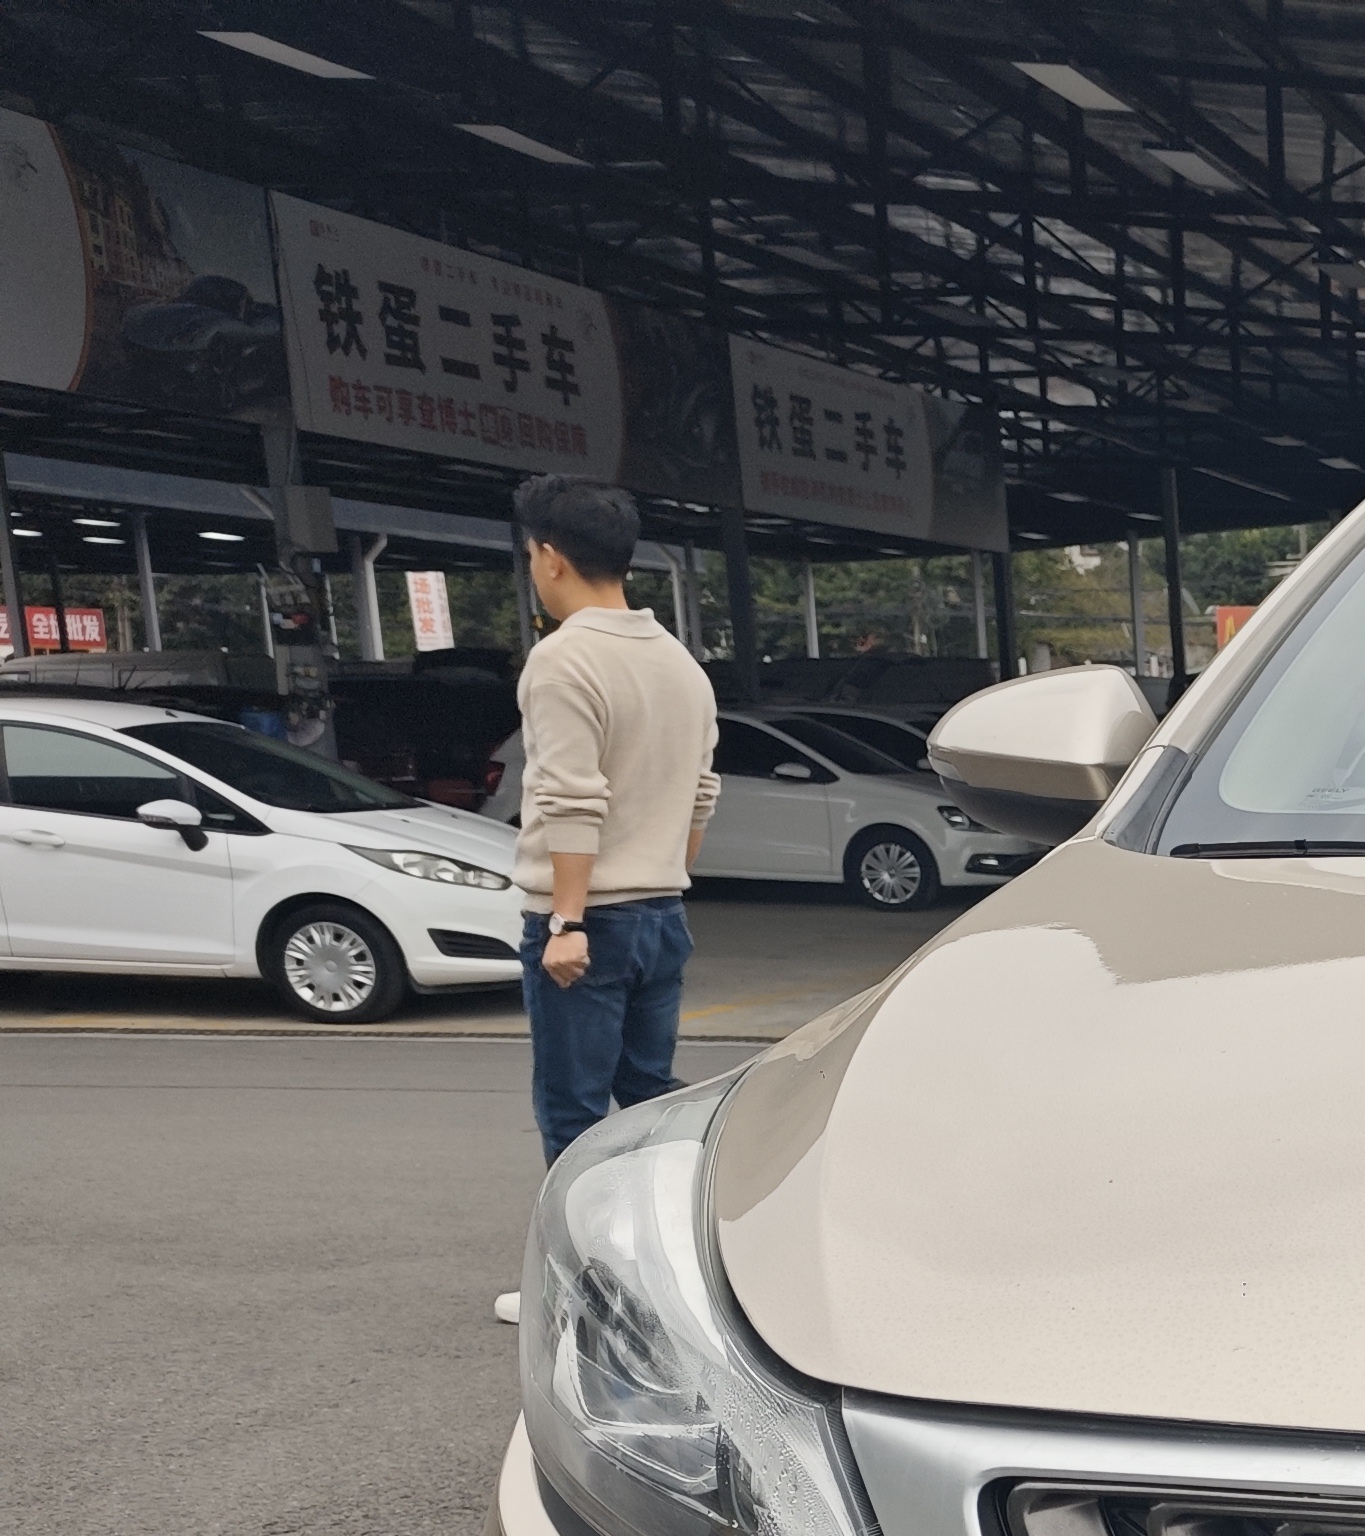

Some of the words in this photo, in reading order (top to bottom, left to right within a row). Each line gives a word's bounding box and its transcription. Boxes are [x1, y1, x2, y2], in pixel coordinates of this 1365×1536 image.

[313, 263, 582, 406] 铁蛋二手车
[751, 383, 907, 479] 铁蛋二手车
[412, 570, 437, 634] 场批发
